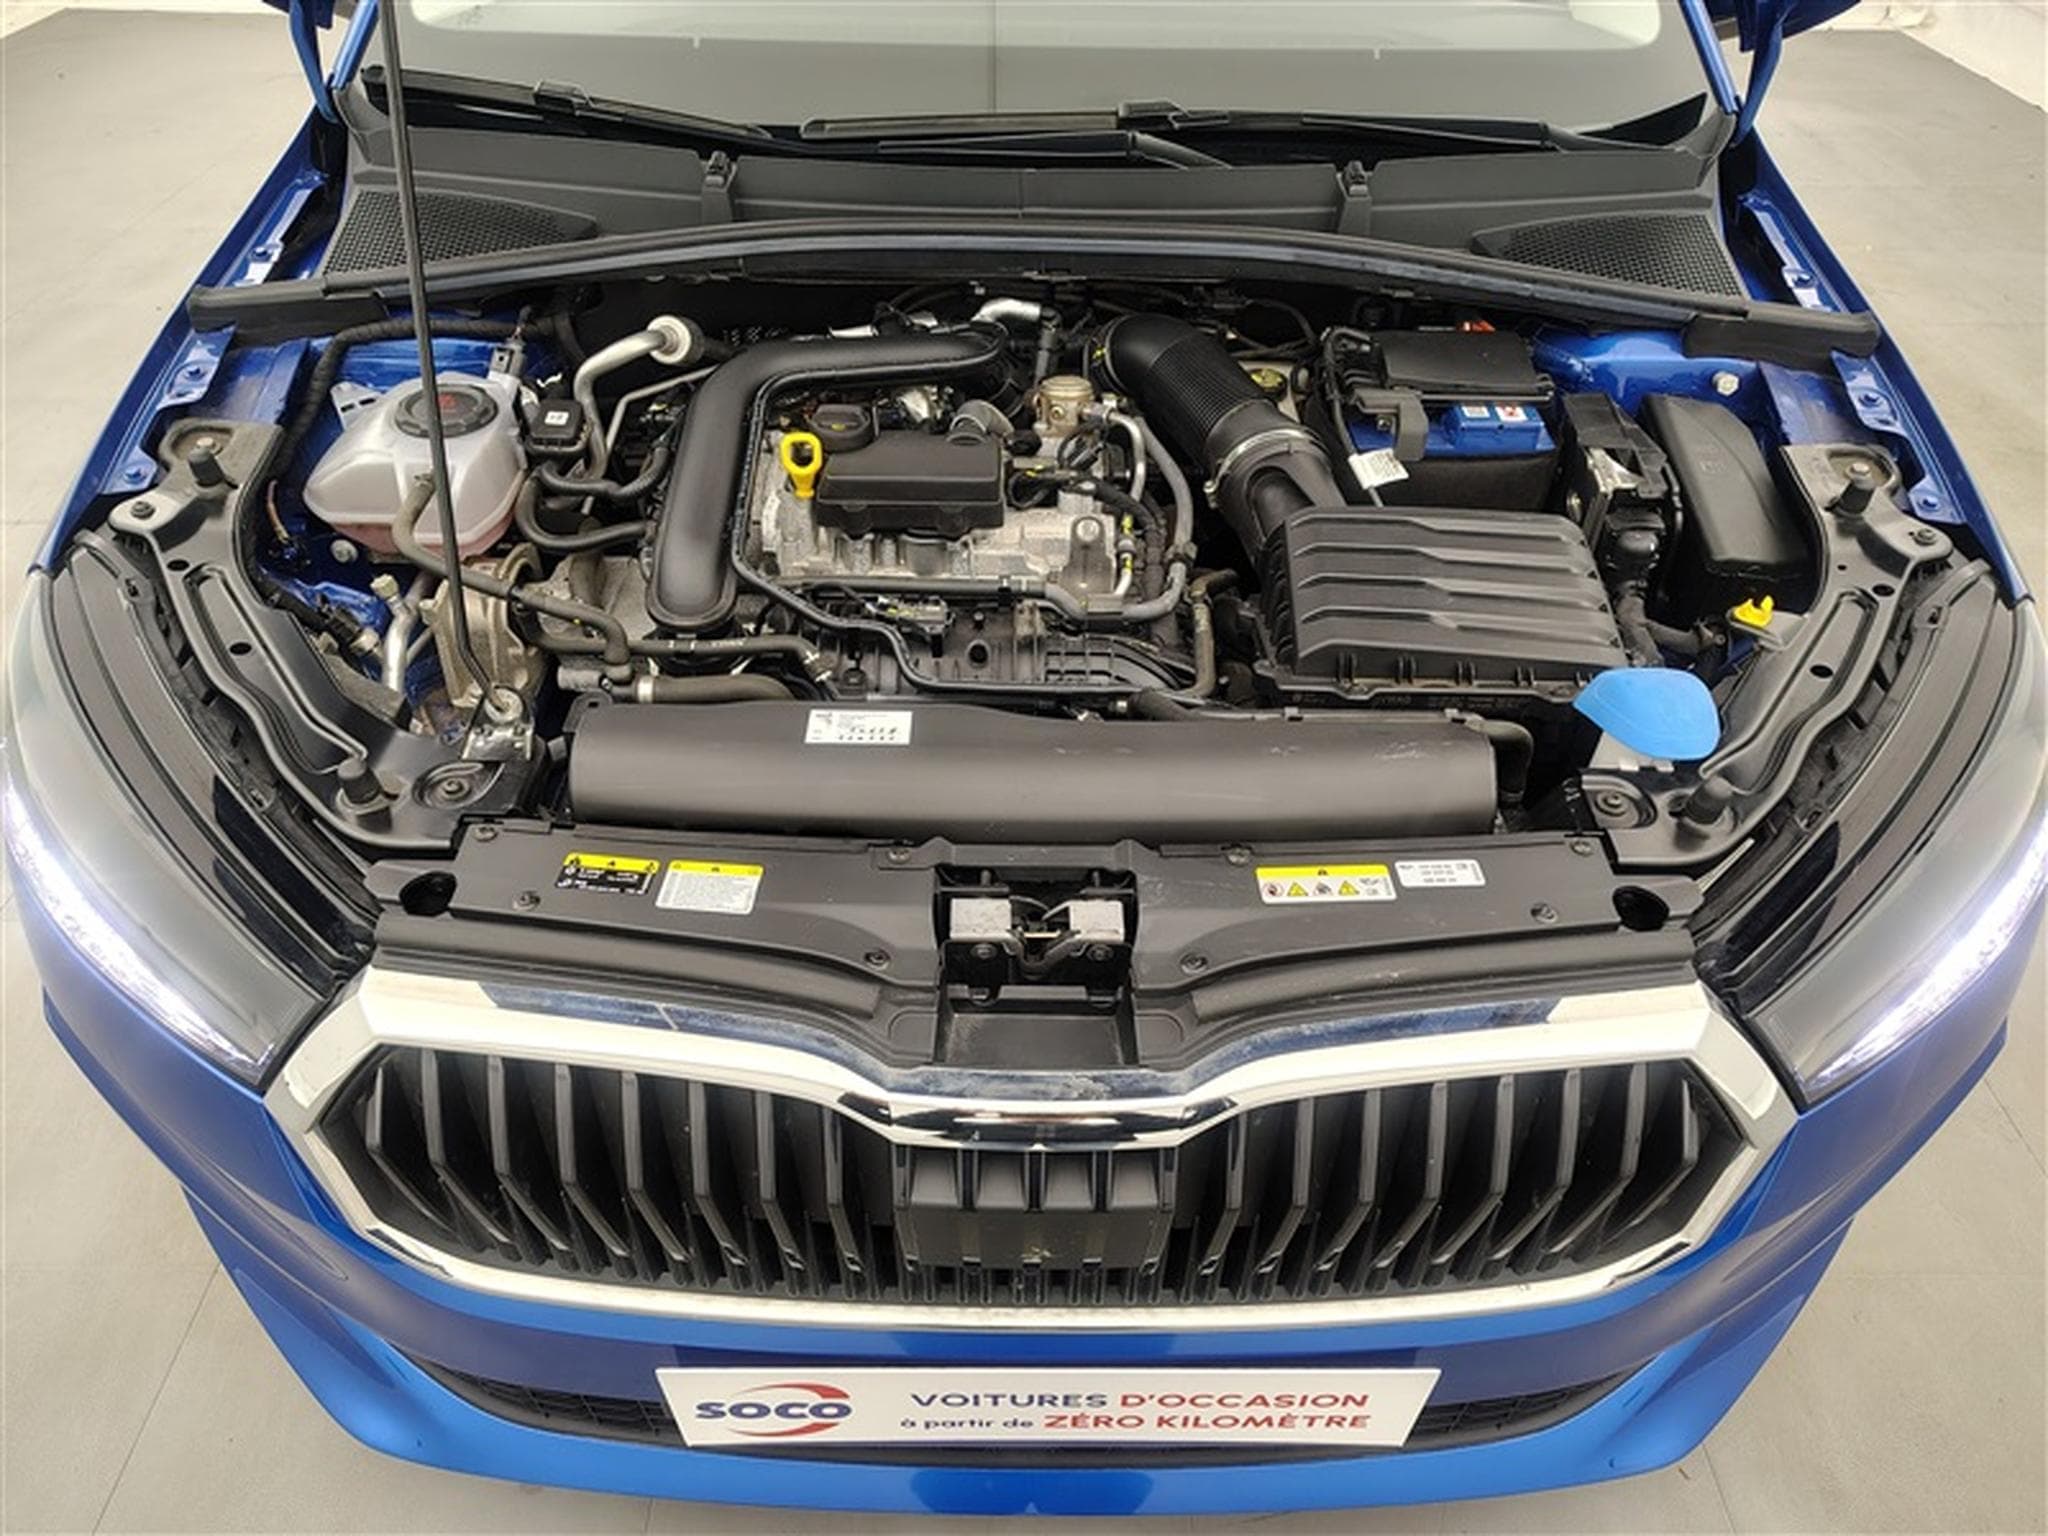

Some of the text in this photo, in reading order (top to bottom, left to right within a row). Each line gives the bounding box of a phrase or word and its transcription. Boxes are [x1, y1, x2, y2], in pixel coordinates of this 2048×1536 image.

[911, 1393, 1369, 1408] VOITURES D'OCCASION
[696, 1402, 852, 1419] SOCO
[900, 1411, 1371, 1430] à partir de ZÉRO KILOMÈTRE
